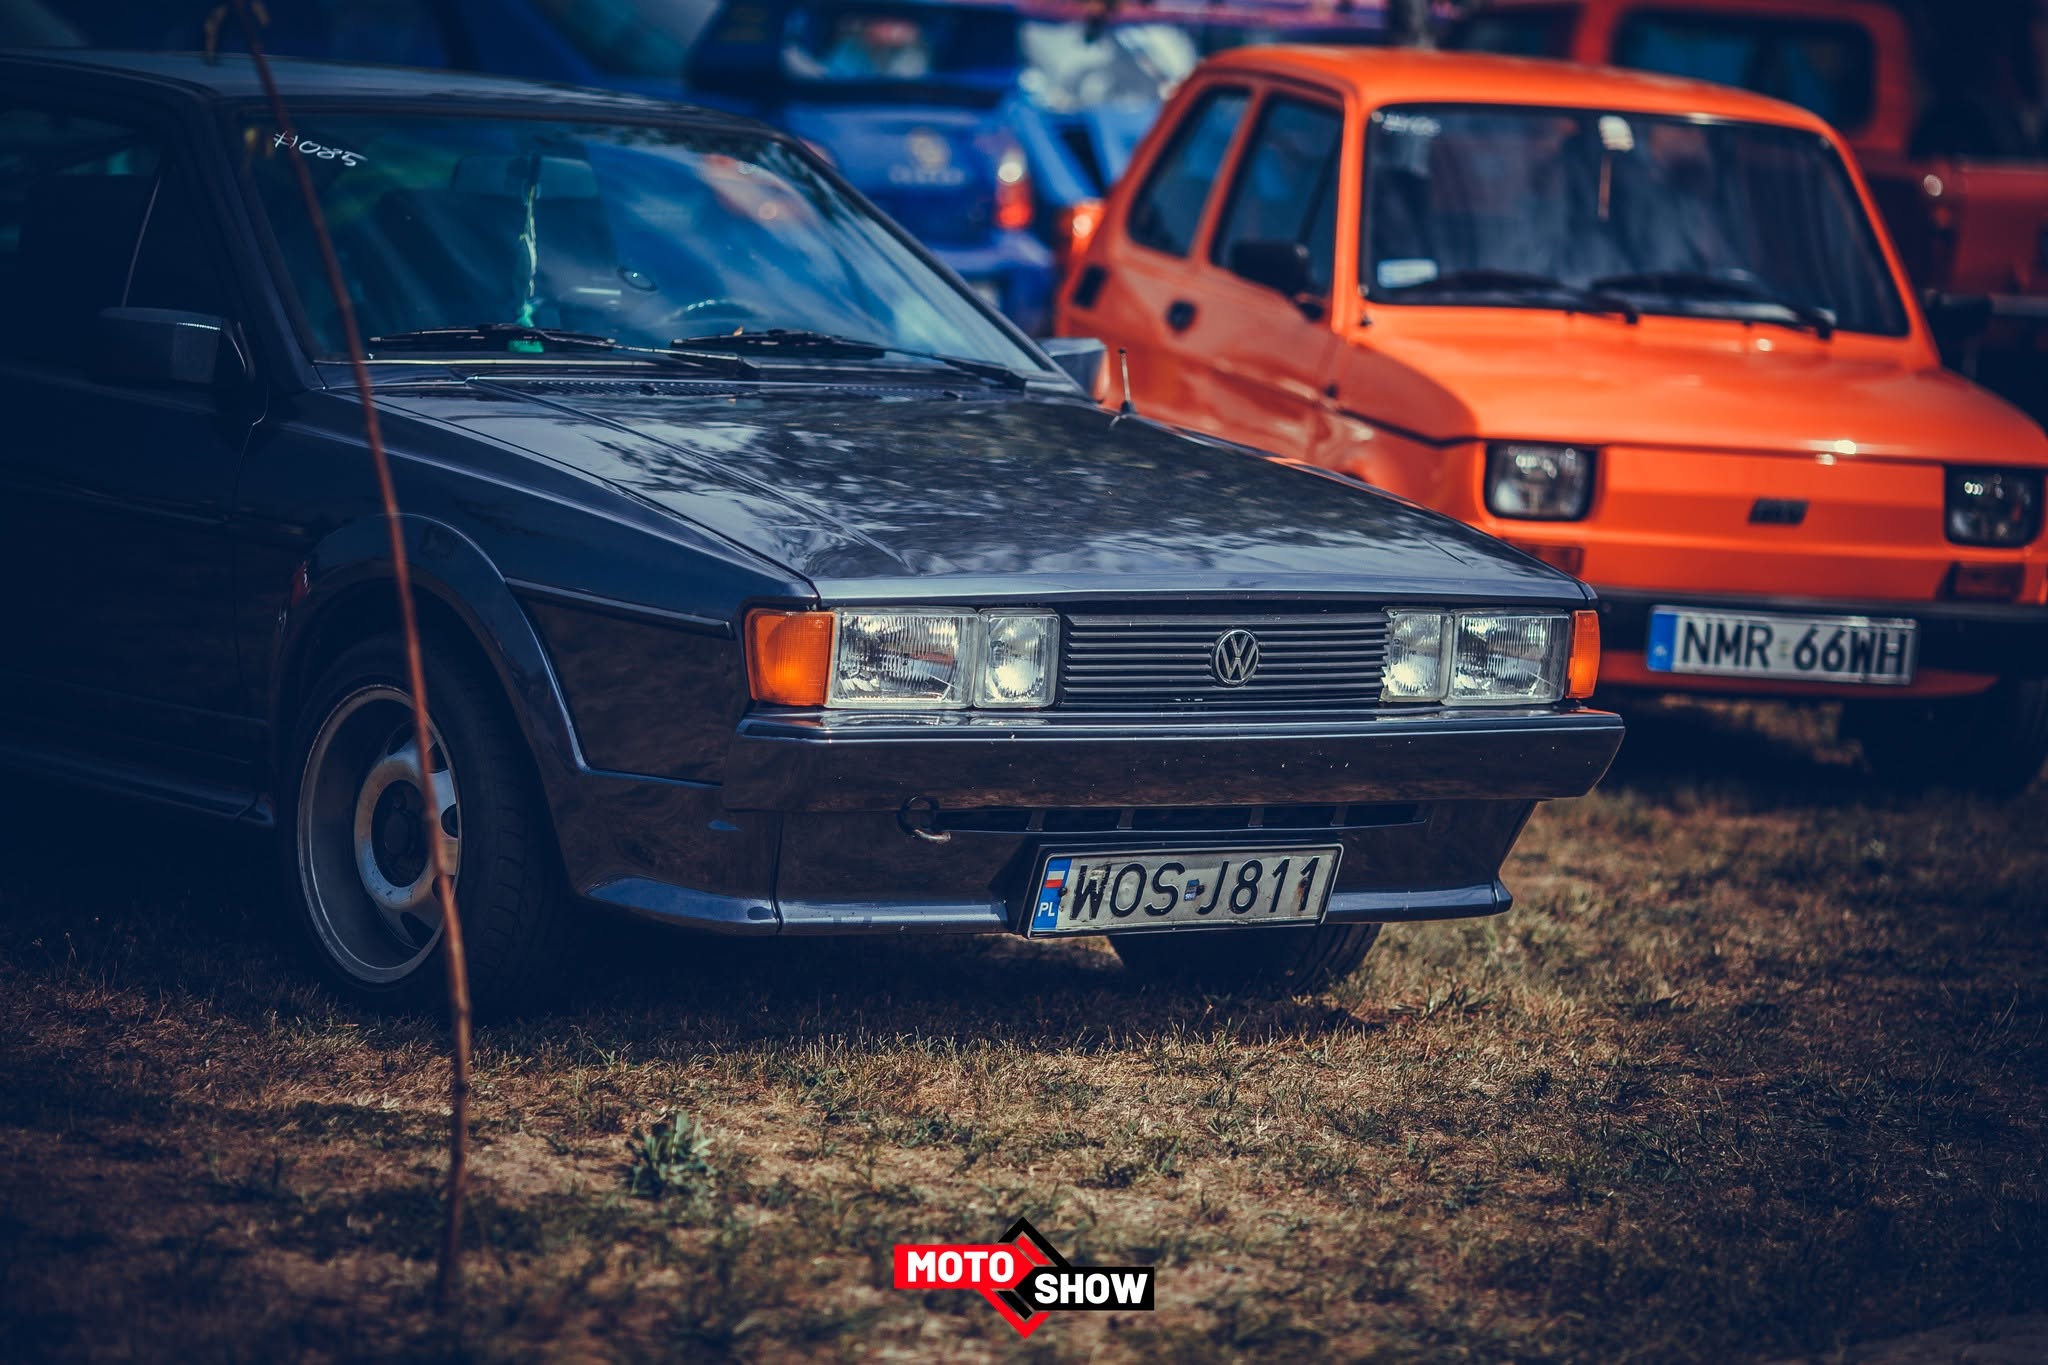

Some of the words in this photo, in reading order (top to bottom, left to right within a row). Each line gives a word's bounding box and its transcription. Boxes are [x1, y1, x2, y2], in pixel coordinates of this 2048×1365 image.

[1682, 620, 1773, 668] NMR
[1793, 625, 1908, 675] 66WH
[1037, 901, 1056, 918] PL
[1069, 861, 1186, 921] WOS
[1195, 855, 1320, 916] J811
